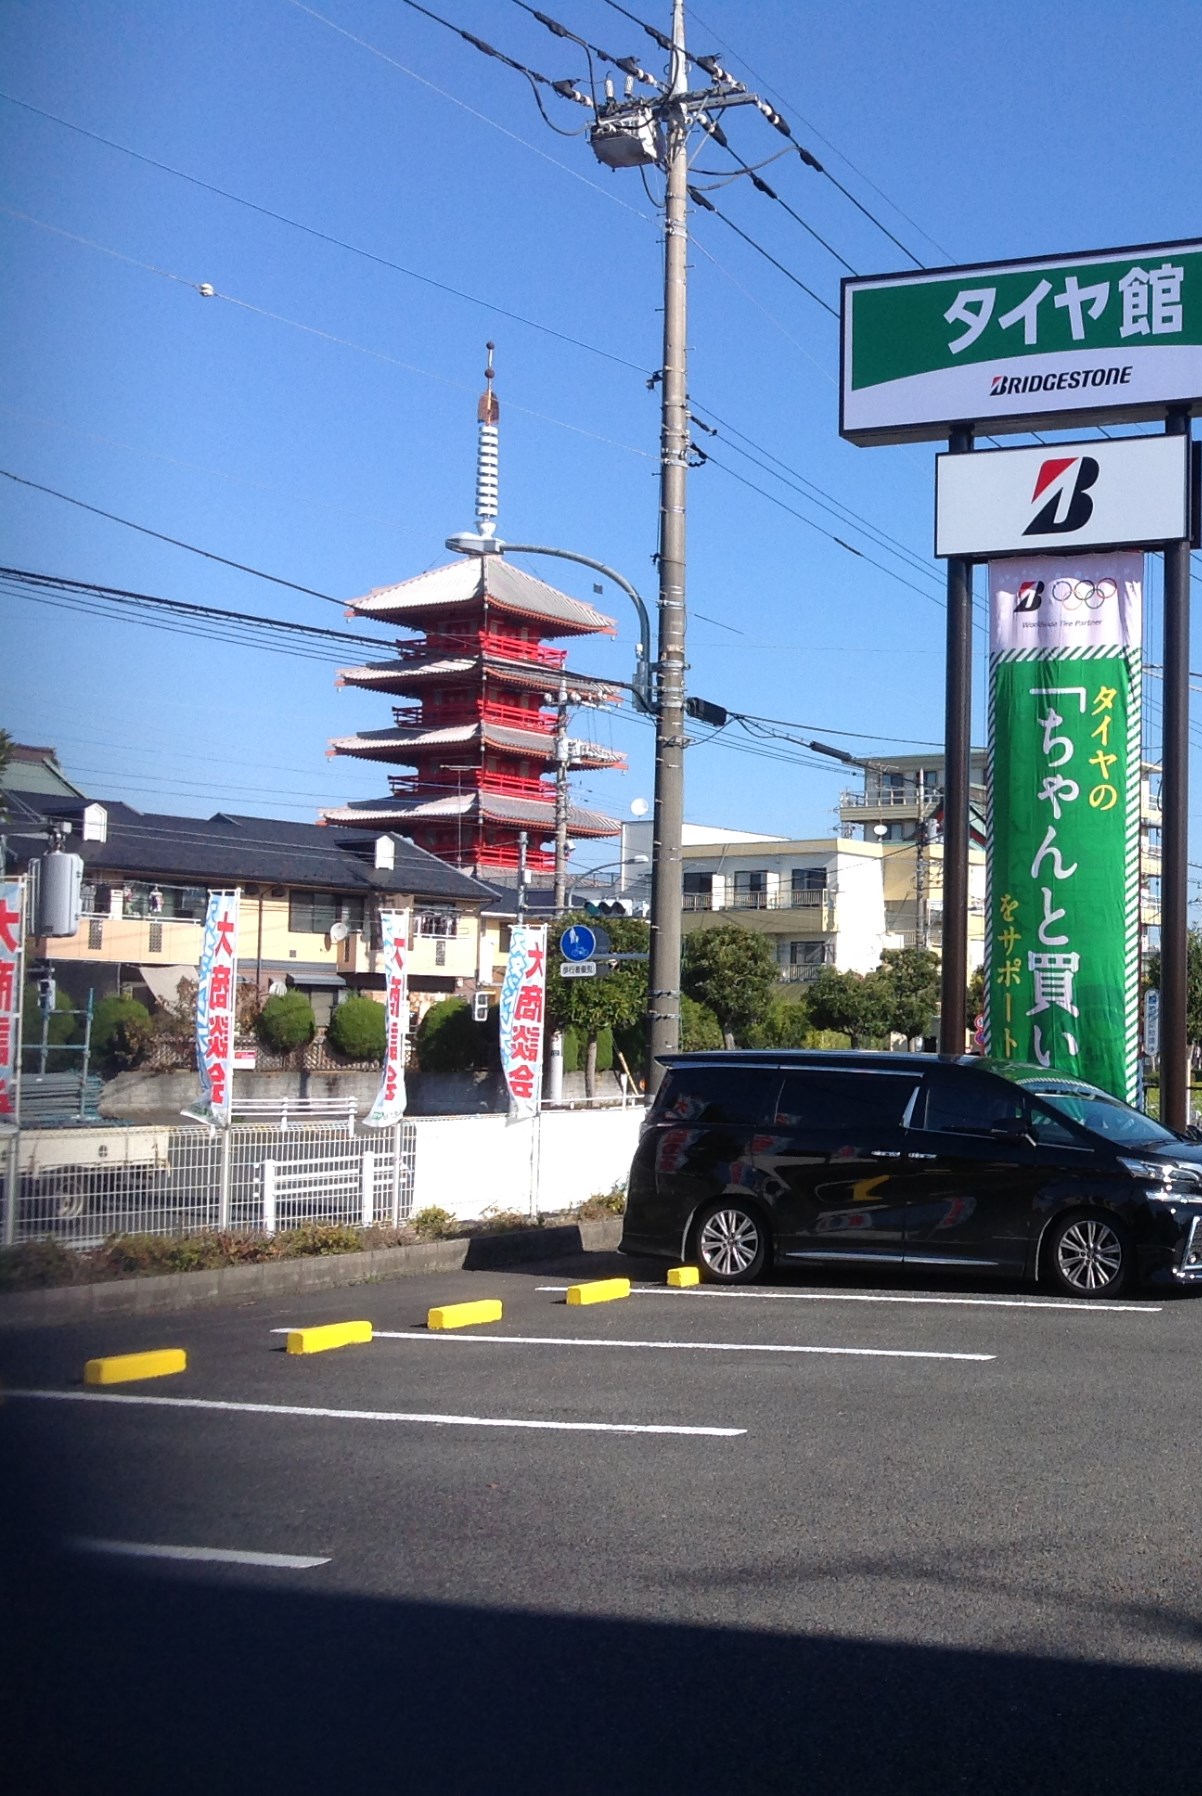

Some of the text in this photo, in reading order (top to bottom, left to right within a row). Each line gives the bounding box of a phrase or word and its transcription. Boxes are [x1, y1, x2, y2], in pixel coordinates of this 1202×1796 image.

[943, 263, 1184, 355] タイヤ館
[989, 365, 1133, 397] BRIDGESTONE
[1075, 618, 1103, 627] Partner
[1088, 685, 1118, 812] タイヤの
[997, 893, 1022, 1058] をサポート
